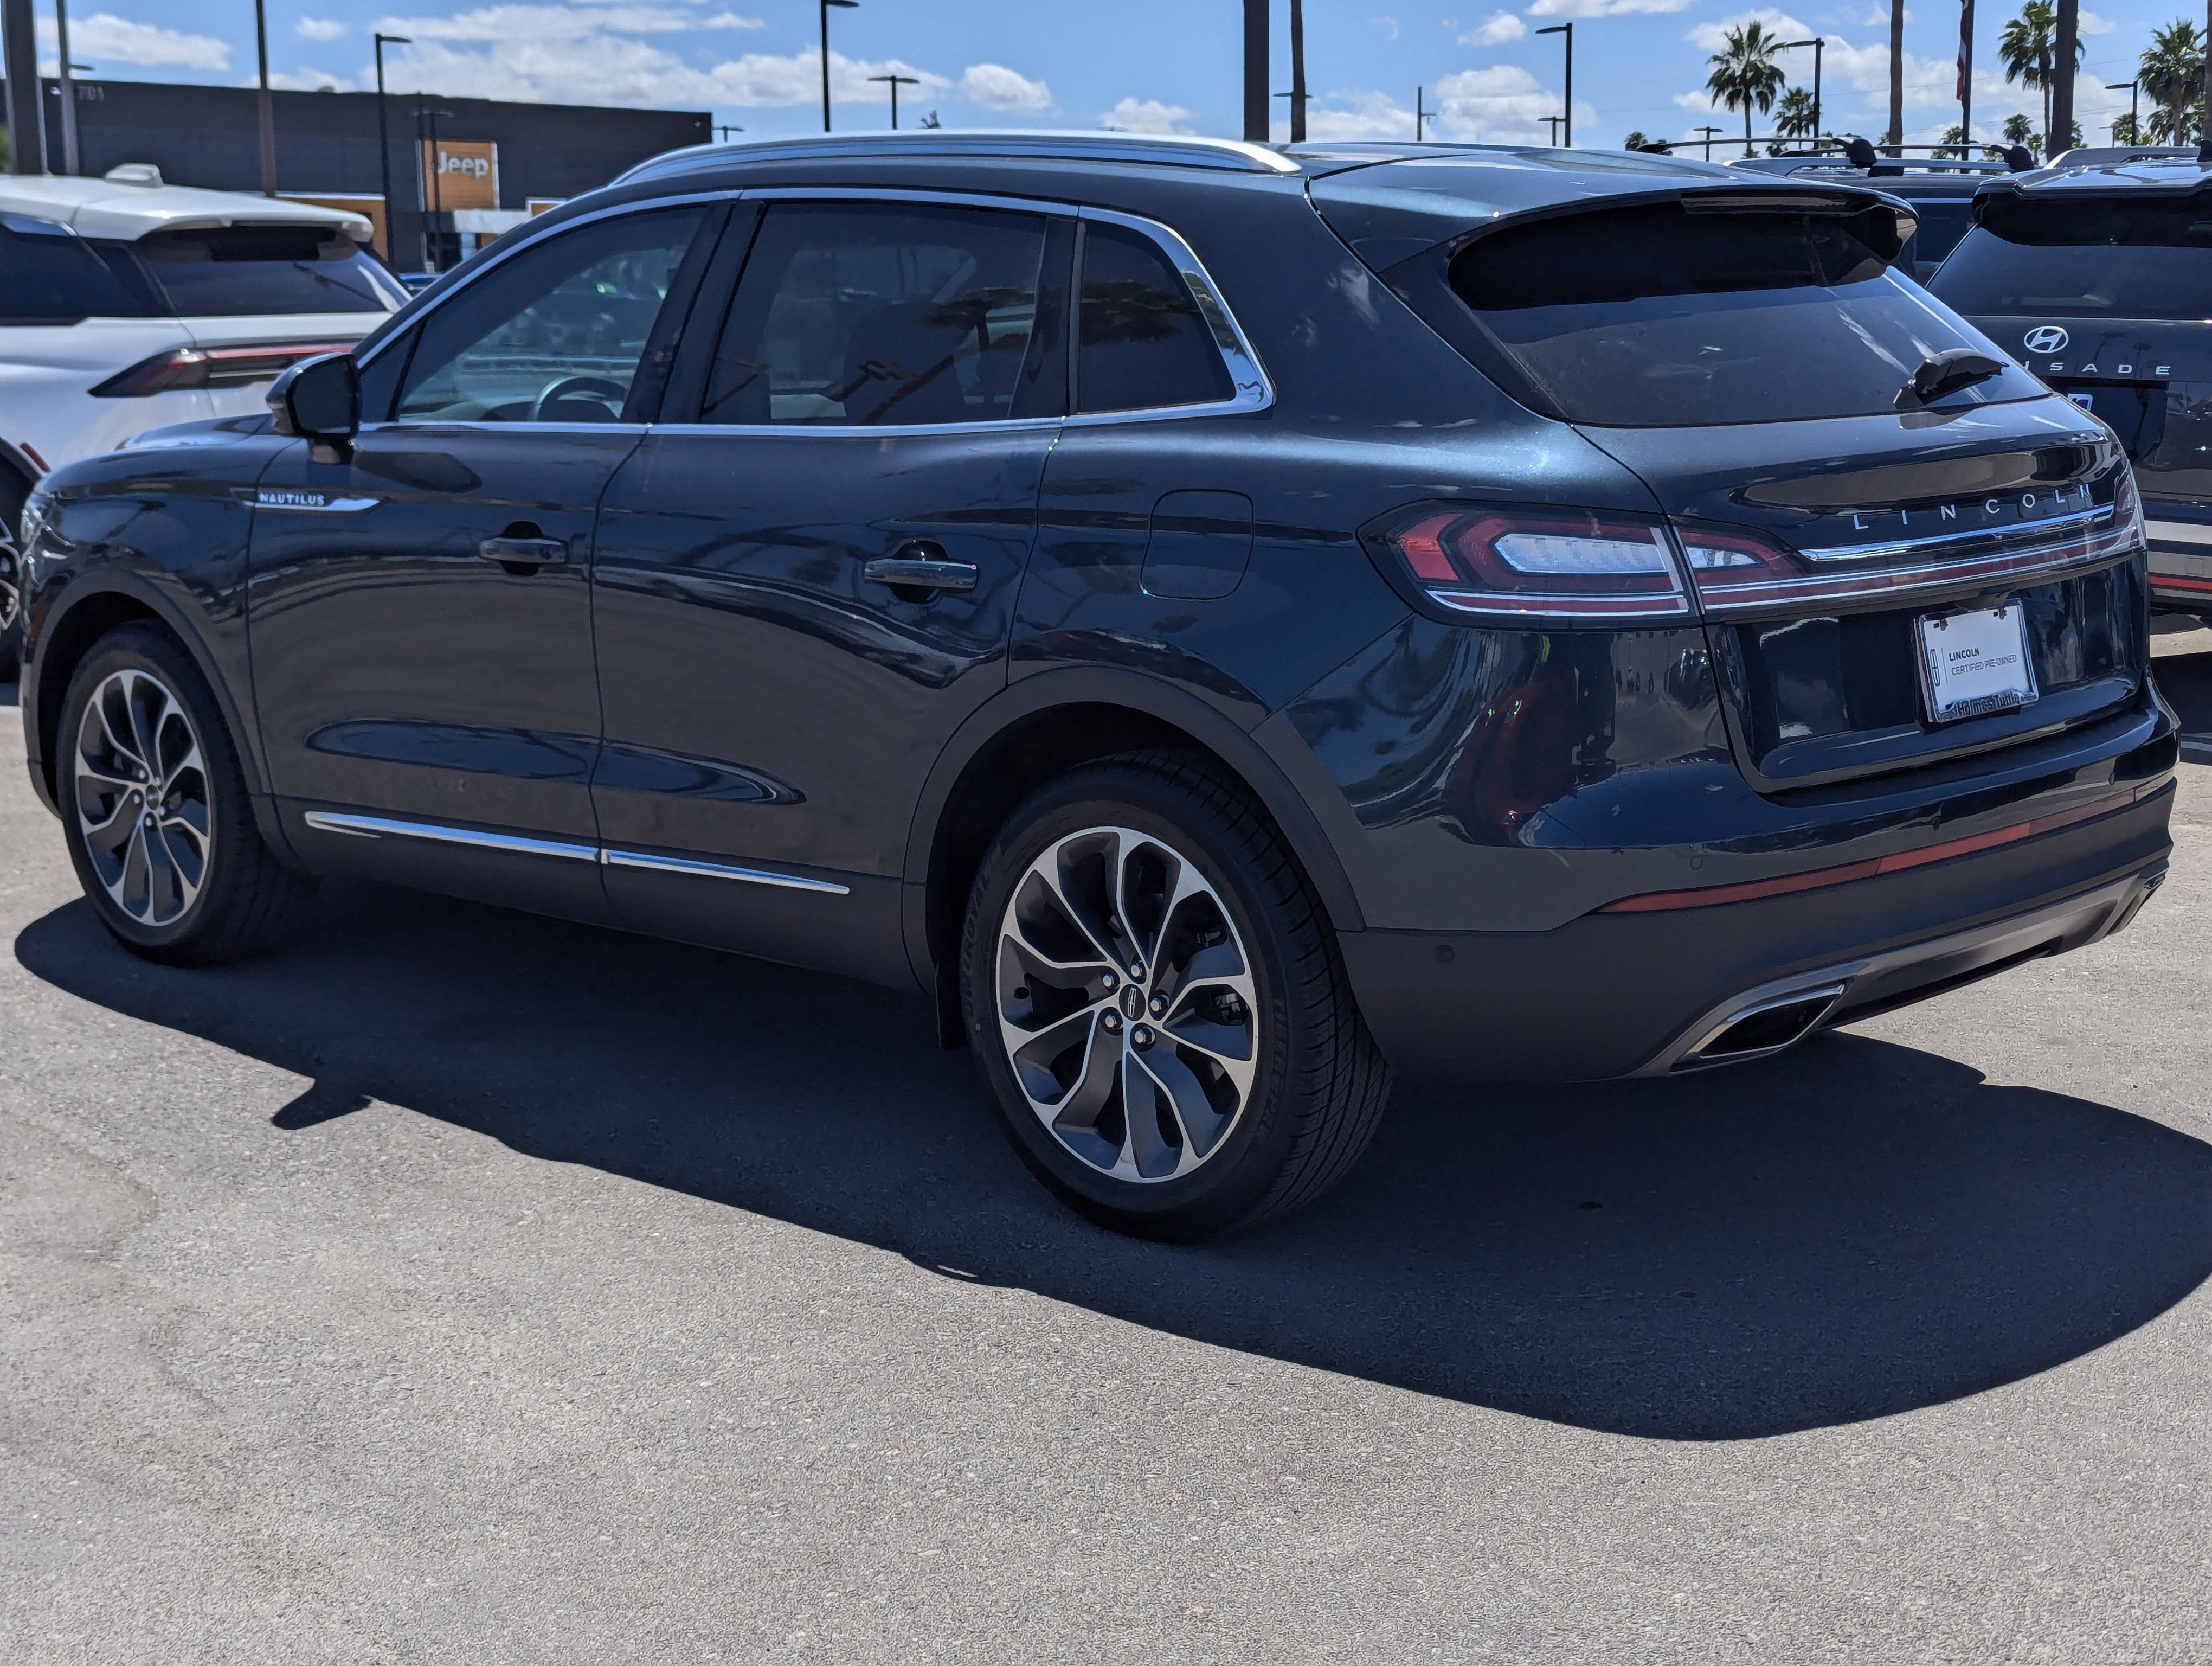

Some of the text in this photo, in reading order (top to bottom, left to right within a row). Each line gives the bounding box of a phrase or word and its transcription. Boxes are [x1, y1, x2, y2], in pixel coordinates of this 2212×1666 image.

[438, 150, 488, 179] Jeep
[258, 492, 325, 505] NAUTILUS
[1853, 483, 2092, 530] LINCOLN
[1949, 647, 1980, 661] LINCOLN
[1952, 661, 1984, 675] CERTIFIED
